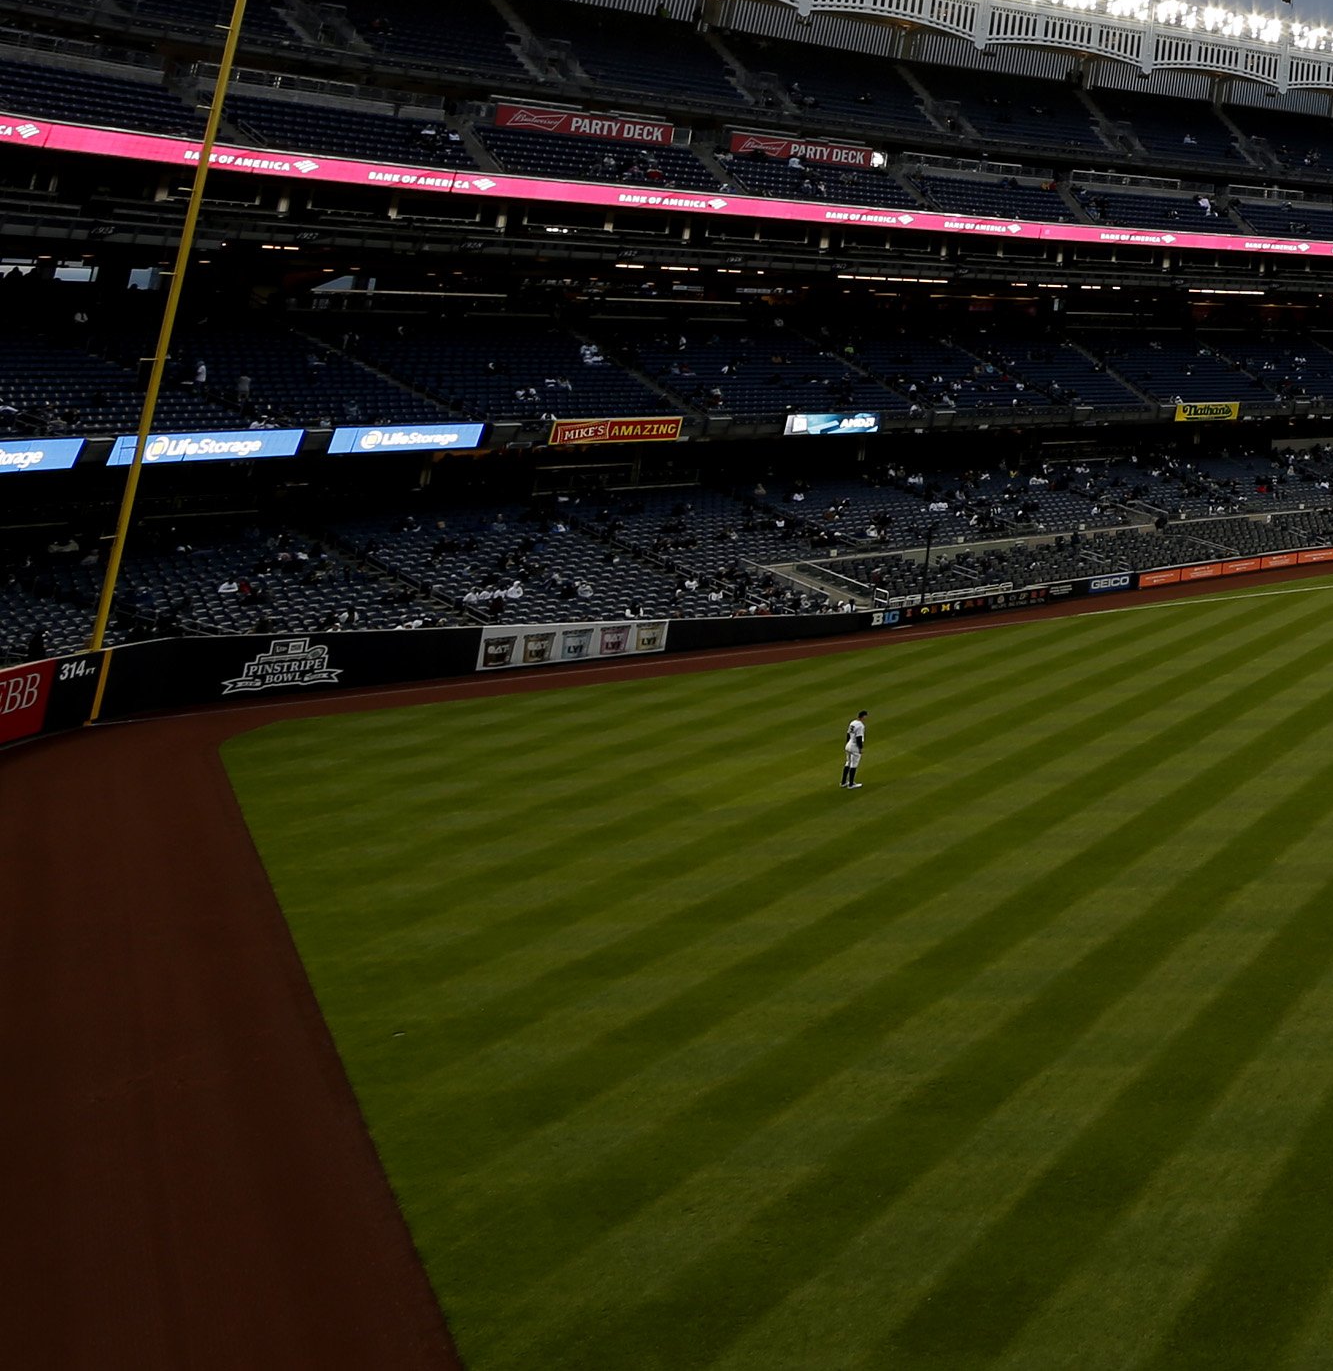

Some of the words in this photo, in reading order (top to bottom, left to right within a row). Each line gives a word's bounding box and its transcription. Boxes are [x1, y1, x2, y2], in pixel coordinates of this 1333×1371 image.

[570, 118, 619, 136] PARTY
[623, 123, 663, 141] DECK
[184, 151, 217, 162] BAK
[219, 155, 234, 163] OF
[233, 157, 290, 170] AMERICA
[790, 144, 830, 160] PARTY
[832, 148, 865, 164] DECK
[369, 172, 400, 182] BANK
[399, 175, 417, 183] OF
[415, 176, 469, 188] AMERICA
[619, 194, 647, 203] BANK
[663, 199, 706, 208] AMERICA
[861, 215, 896, 223] AMERICA
[1183, 404, 1232, 415] Nathan's
[564, 424, 605, 440] MIKE'S
[610, 423, 677, 436] AMAZING
[1090, 575, 1130, 590] GEICO
[248, 658, 324, 676] PINSTRIPE
[265, 672, 301, 684] BOWL
